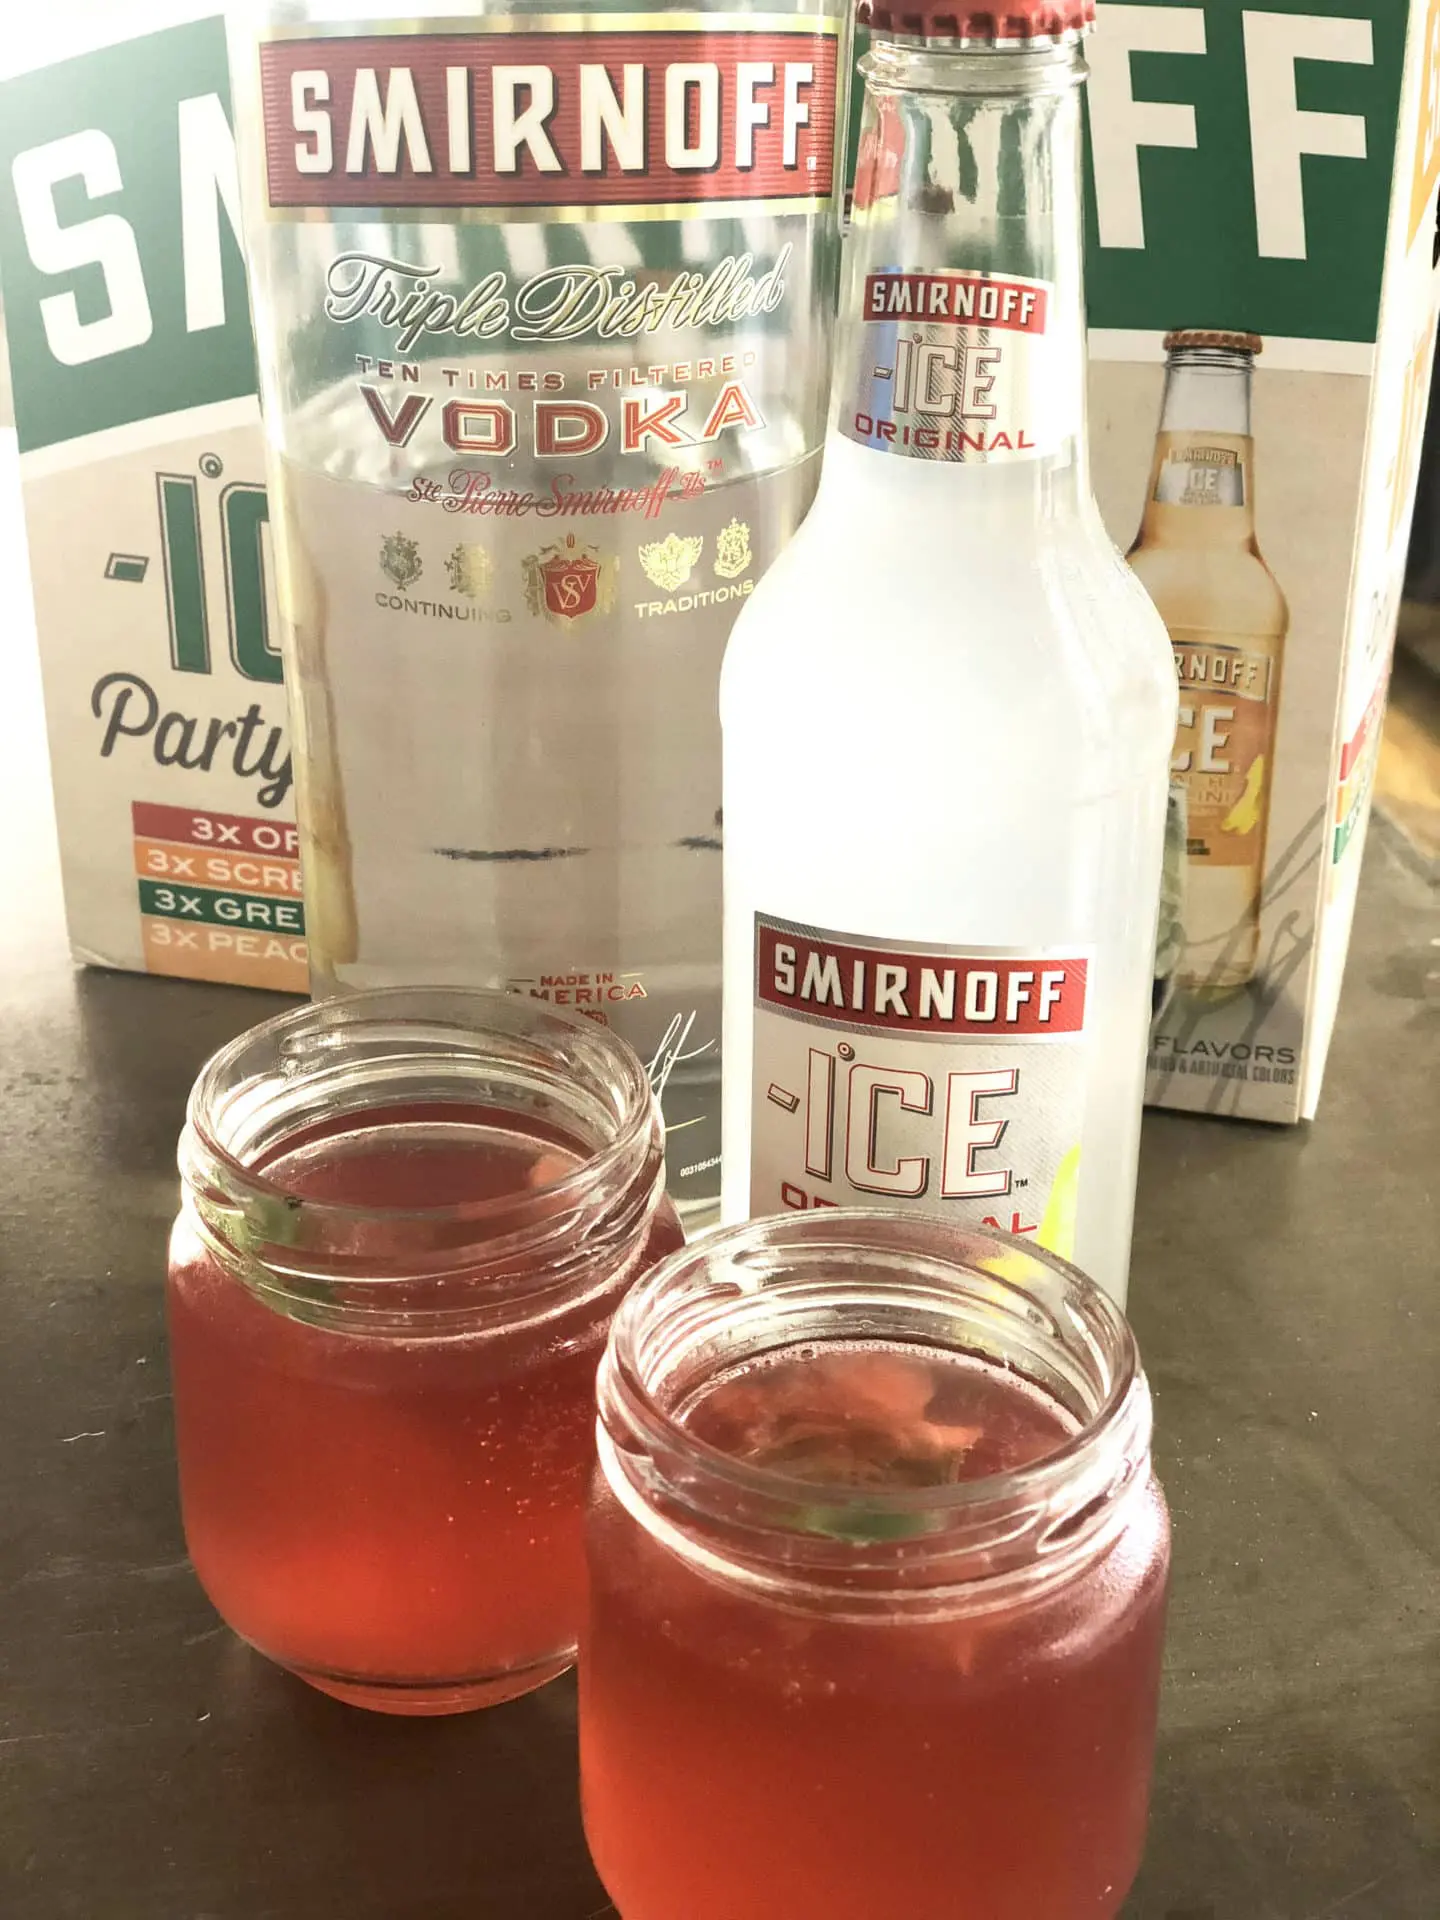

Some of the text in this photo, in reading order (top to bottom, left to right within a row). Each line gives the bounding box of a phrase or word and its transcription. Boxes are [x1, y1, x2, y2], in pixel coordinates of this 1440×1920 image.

[291, 62, 814, 174] SMIRNOFF
[325, 241, 794, 354] Triple Distilled
[871, 279, 1037, 325] SMIRNOFF
[355, 350, 757, 392] TEN TIMES FILTERED
[359, 379, 767, 458] VODKA
[854, 412, 1037, 452] ORIGINAL
[405, 476, 443, 503] Ste
[441, 467, 536, 517] Pierre
[534, 465, 680, 520] Smirnoff
[374, 592, 513, 624] CONTINUING
[633, 579, 755, 619] TRADITIONS
[91, 672, 294, 809] Party
[191, 817, 242, 845] 3X
[147, 849, 198, 877] 3X
[154, 888, 301, 929] 3X GRE
[150, 922, 200, 949] 3X
[507, 982, 648, 1005] MERICA
[540, 972, 614, 987] MADE IN
[774, 942, 1067, 1025] SMIRNOFF
[1152, 1035, 1296, 1065] FLAVORS
